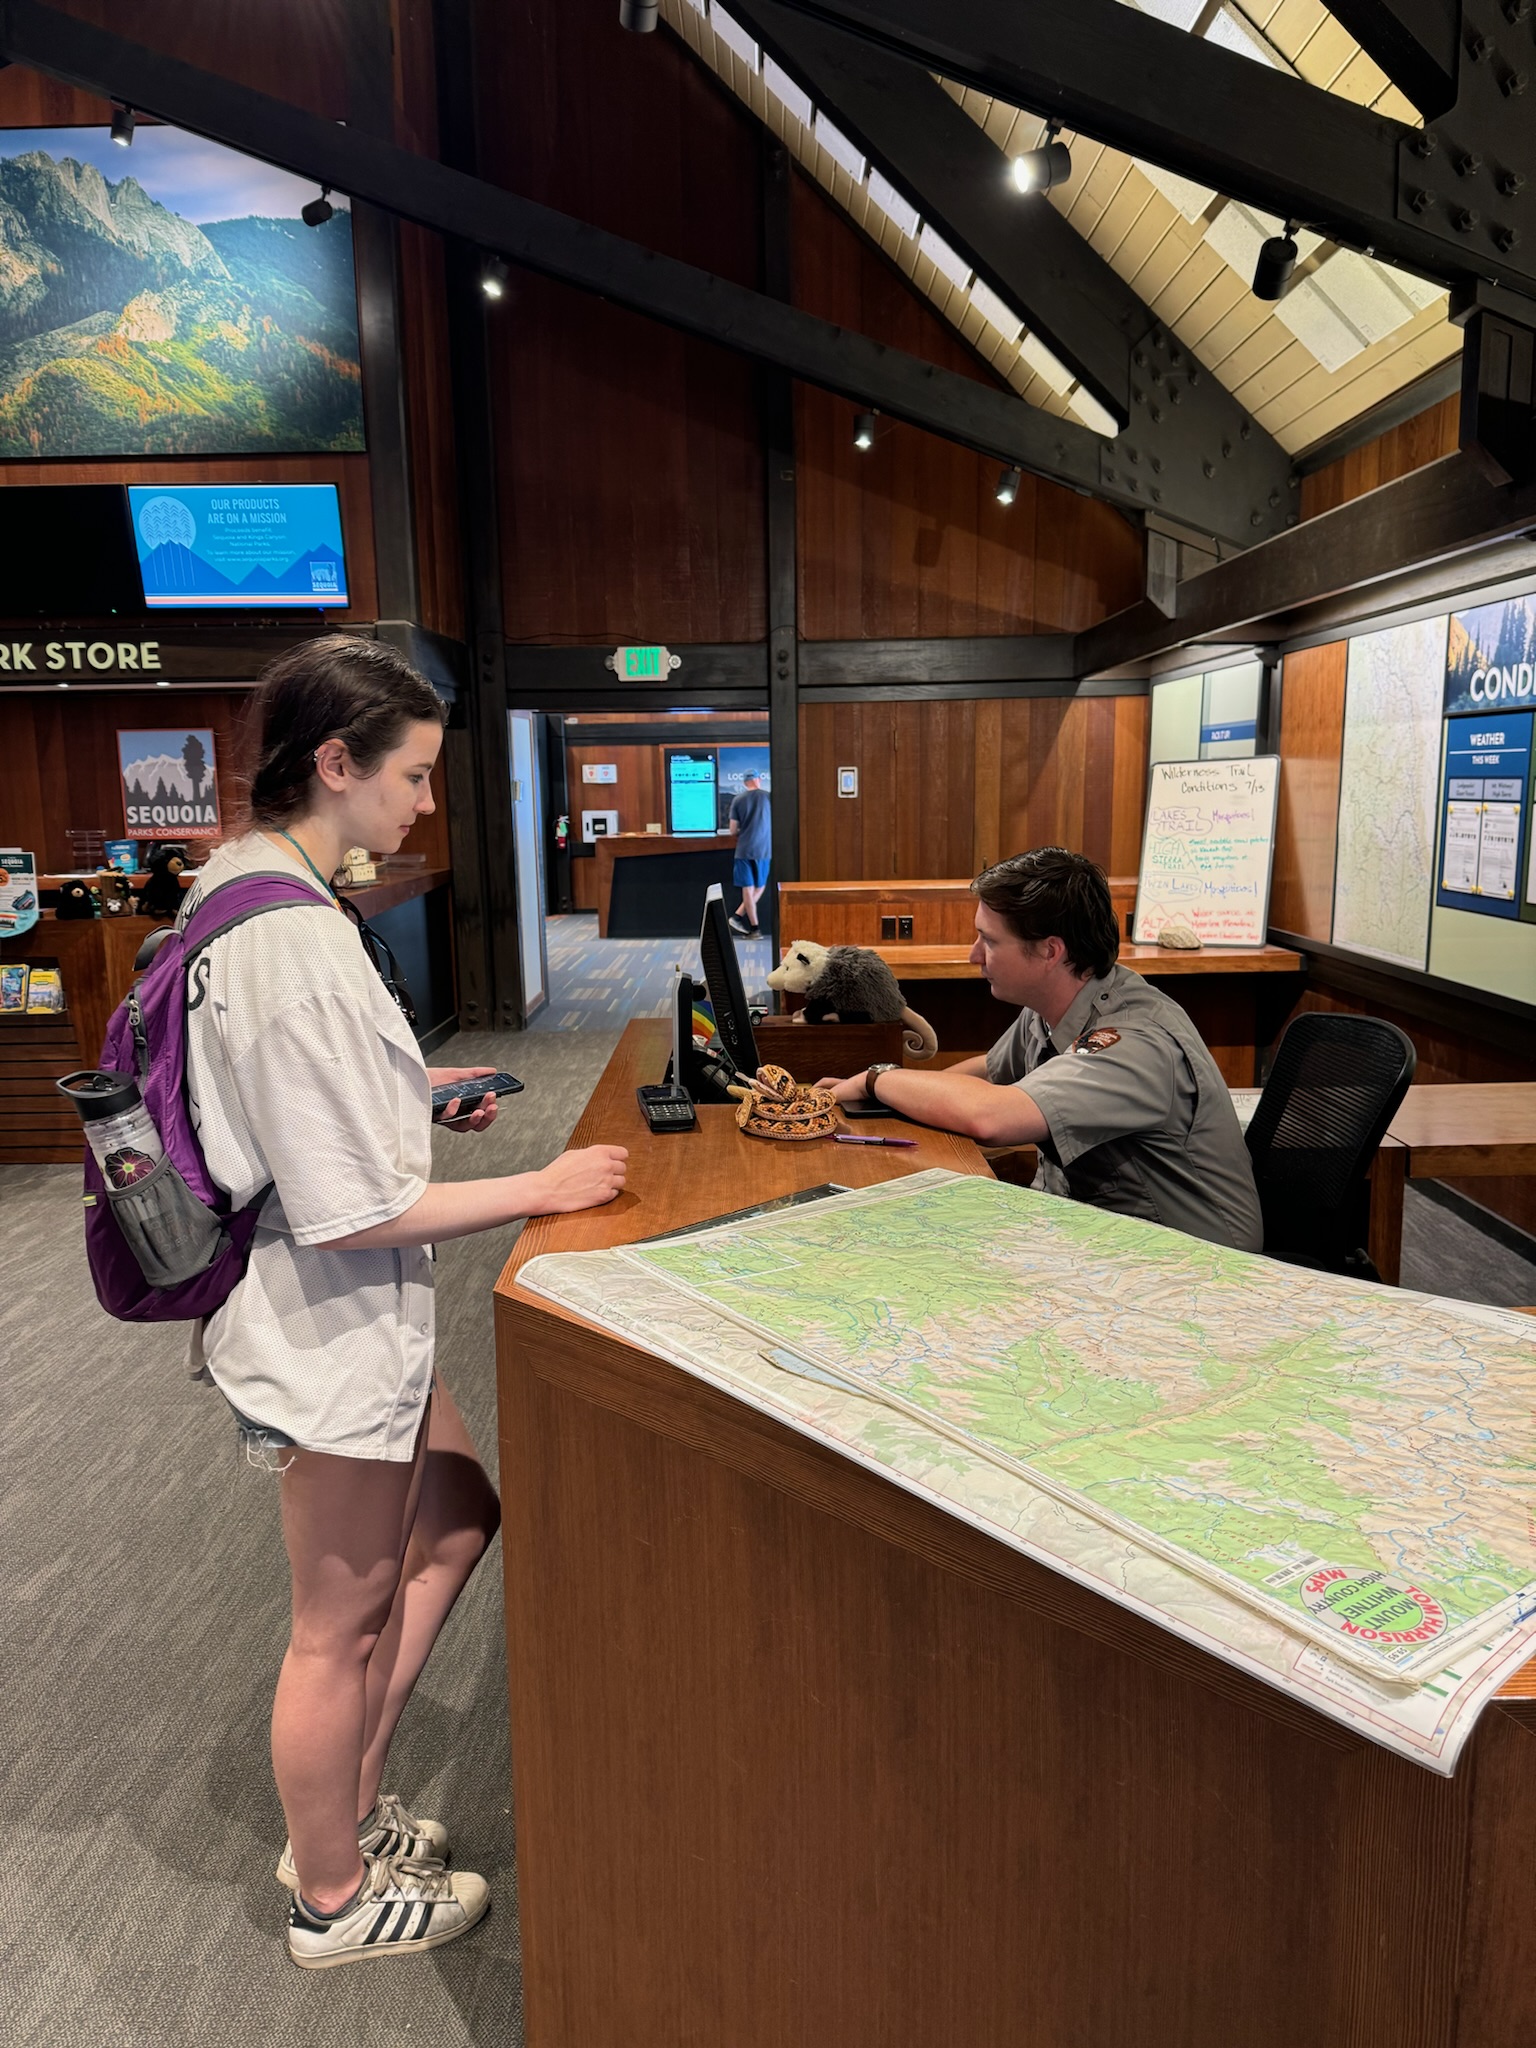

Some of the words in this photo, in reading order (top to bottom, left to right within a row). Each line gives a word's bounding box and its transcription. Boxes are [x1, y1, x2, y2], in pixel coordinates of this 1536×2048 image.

[211, 499, 230, 510] OUR
[232, 498, 280, 510] PRODUCTS
[207, 512, 225, 524] ARE
[226, 512, 240, 524] ON
[241, 512, 249, 523] A
[249, 512, 287, 524] MISSION
[45, 641, 162, 670] STORE
[625, 647, 660, 676] EXIT
[1470, 732, 1505, 746] WEATHER
[1472, 755, 1484, 765] THIS
[1485, 755, 1500, 764] WEEK
[1161, 765, 1220, 780] Wilderness
[1226, 763, 1256, 777] Trail
[1181, 781, 1238, 793] Conditions
[126, 804, 217, 827] SEQUOIA
[1152, 810, 1187, 821] LAKES
[127, 828, 153, 837] PARKS
[155, 827, 219, 837] CONSERVANCY
[1160, 820, 1204, 832] TRAIL
[1149, 841, 1180, 855] HIGH
[1, 858, 24, 866] SEQUOIA
[1152, 855, 1182, 864] SIERRA
[1144, 877, 1168, 889] TWIN
[1141, 917, 1172, 929] ALTA
[1306, 1569, 1347, 1593] MAPS
[1358, 1571, 1386, 1588] HIGH
[1307, 1584, 1359, 1614] COUNTRY
[1338, 1586, 1402, 1621] WHITNEY
[1404, 1585, 1442, 1615] TOM
[1364, 1598, 1419, 1629] MOUNT
[1340, 1616, 1444, 1643] HARRISON
